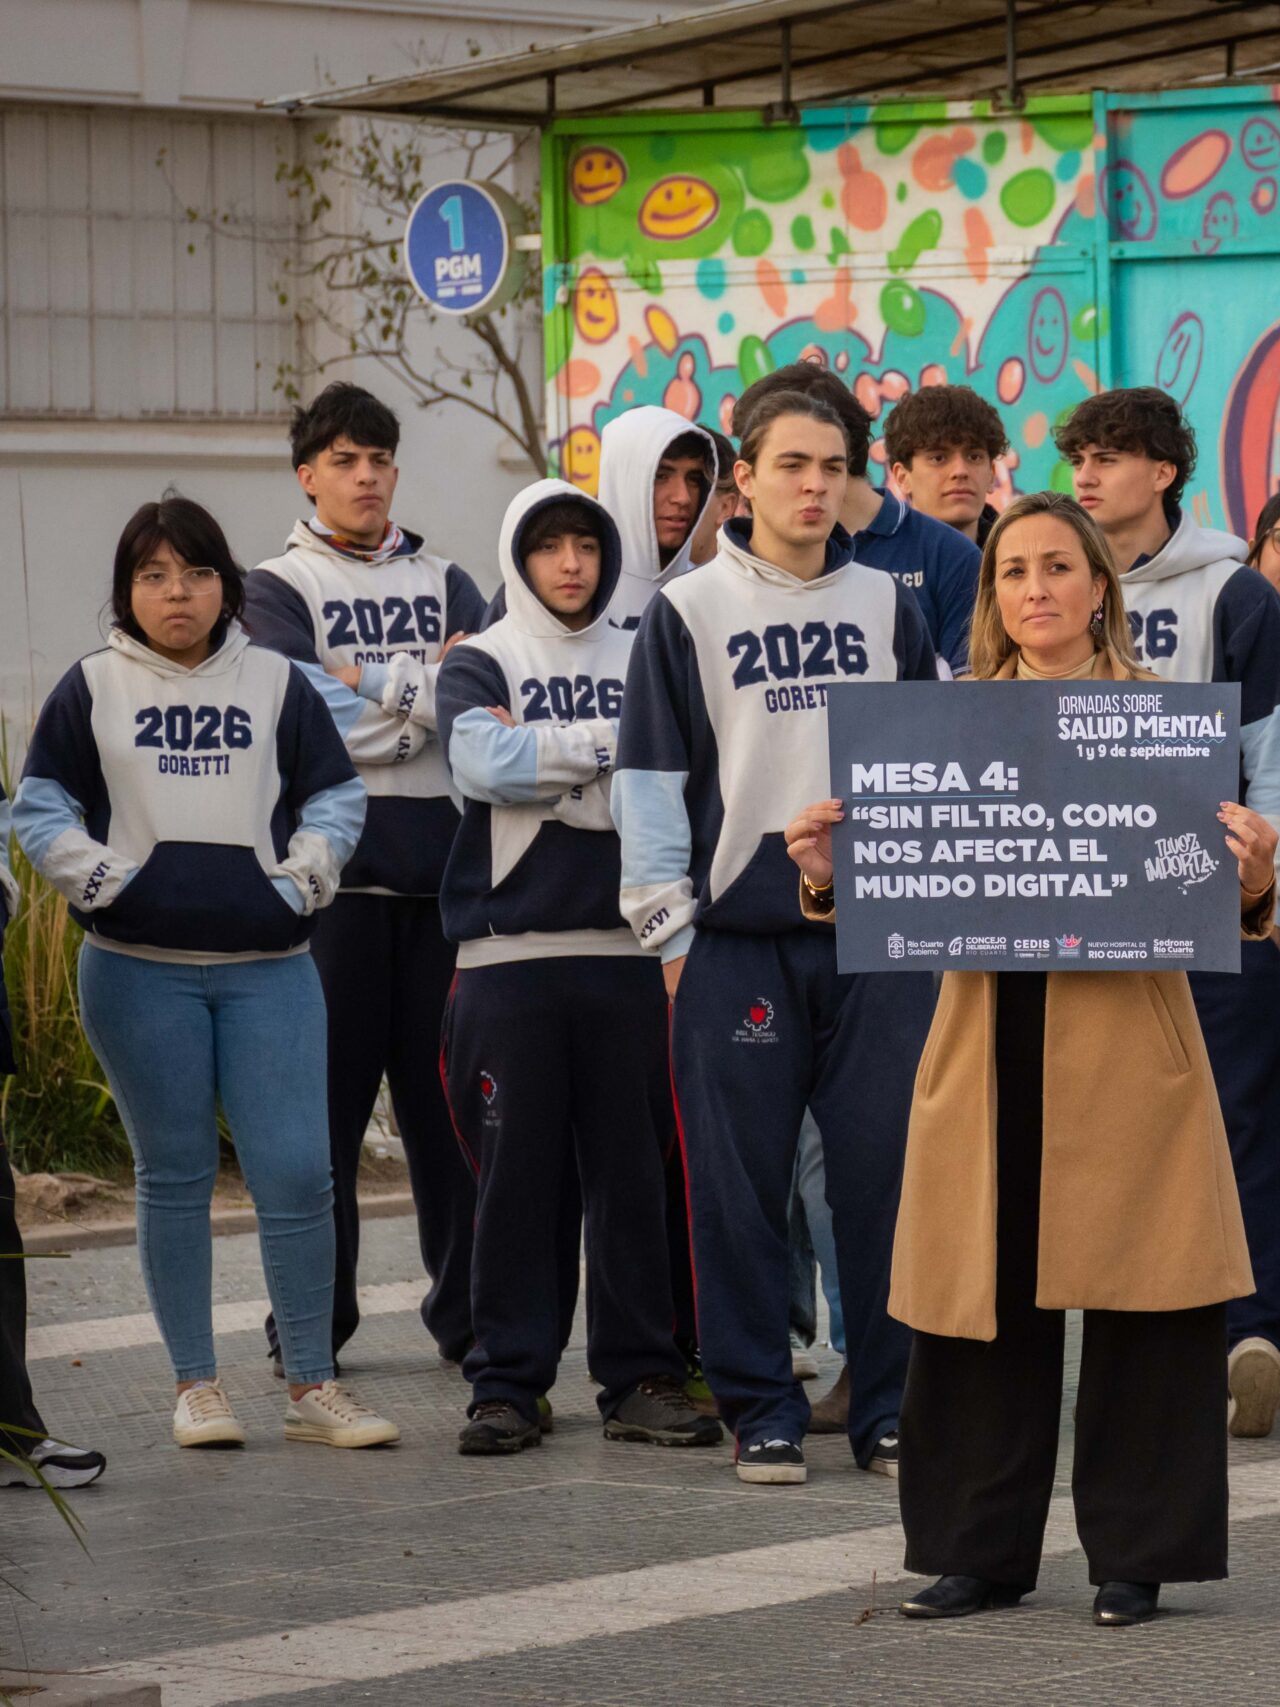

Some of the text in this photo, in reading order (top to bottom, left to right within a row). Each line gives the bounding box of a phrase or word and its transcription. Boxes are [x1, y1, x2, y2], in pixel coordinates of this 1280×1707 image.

[439, 195, 465, 251] 1
[435, 253, 482, 281] PGM
[322, 595, 442, 649] 2026
[1126, 608, 1178, 661] 26
[726, 621, 870, 690] 2026
[520, 674, 625, 723] 2026
[764, 683, 828, 713] GORET
[1057, 694, 1163, 715] JORNADAS SOBRE
[135, 705, 253, 751] 2026
[1058, 714, 1226, 740] SALUD MENTAL
[1076, 743, 1210, 760] 1 y 9 de septiembre
[158, 754, 230, 776] GORETTI
[852, 761, 1019, 793] MESA 4:
[931, 803, 1055, 832] FILTRO,
[1062, 803, 1157, 828] COMO
[854, 838, 1108, 864] NOS AFECTA EL
[83, 861, 111, 904] XXVI
[855, 874, 976, 899] MUNDO
[907, 948, 939, 956] Gobierno
[920, 940, 944, 948] Cuarto
[966, 936, 1007, 944] CONCEJO
[1013, 939, 1050, 948] CEDIS
[1153, 939, 1193, 947] Sedronar
[1168, 946, 1194, 954] Cuarto
[1106, 950, 1148, 959] CUARTO
